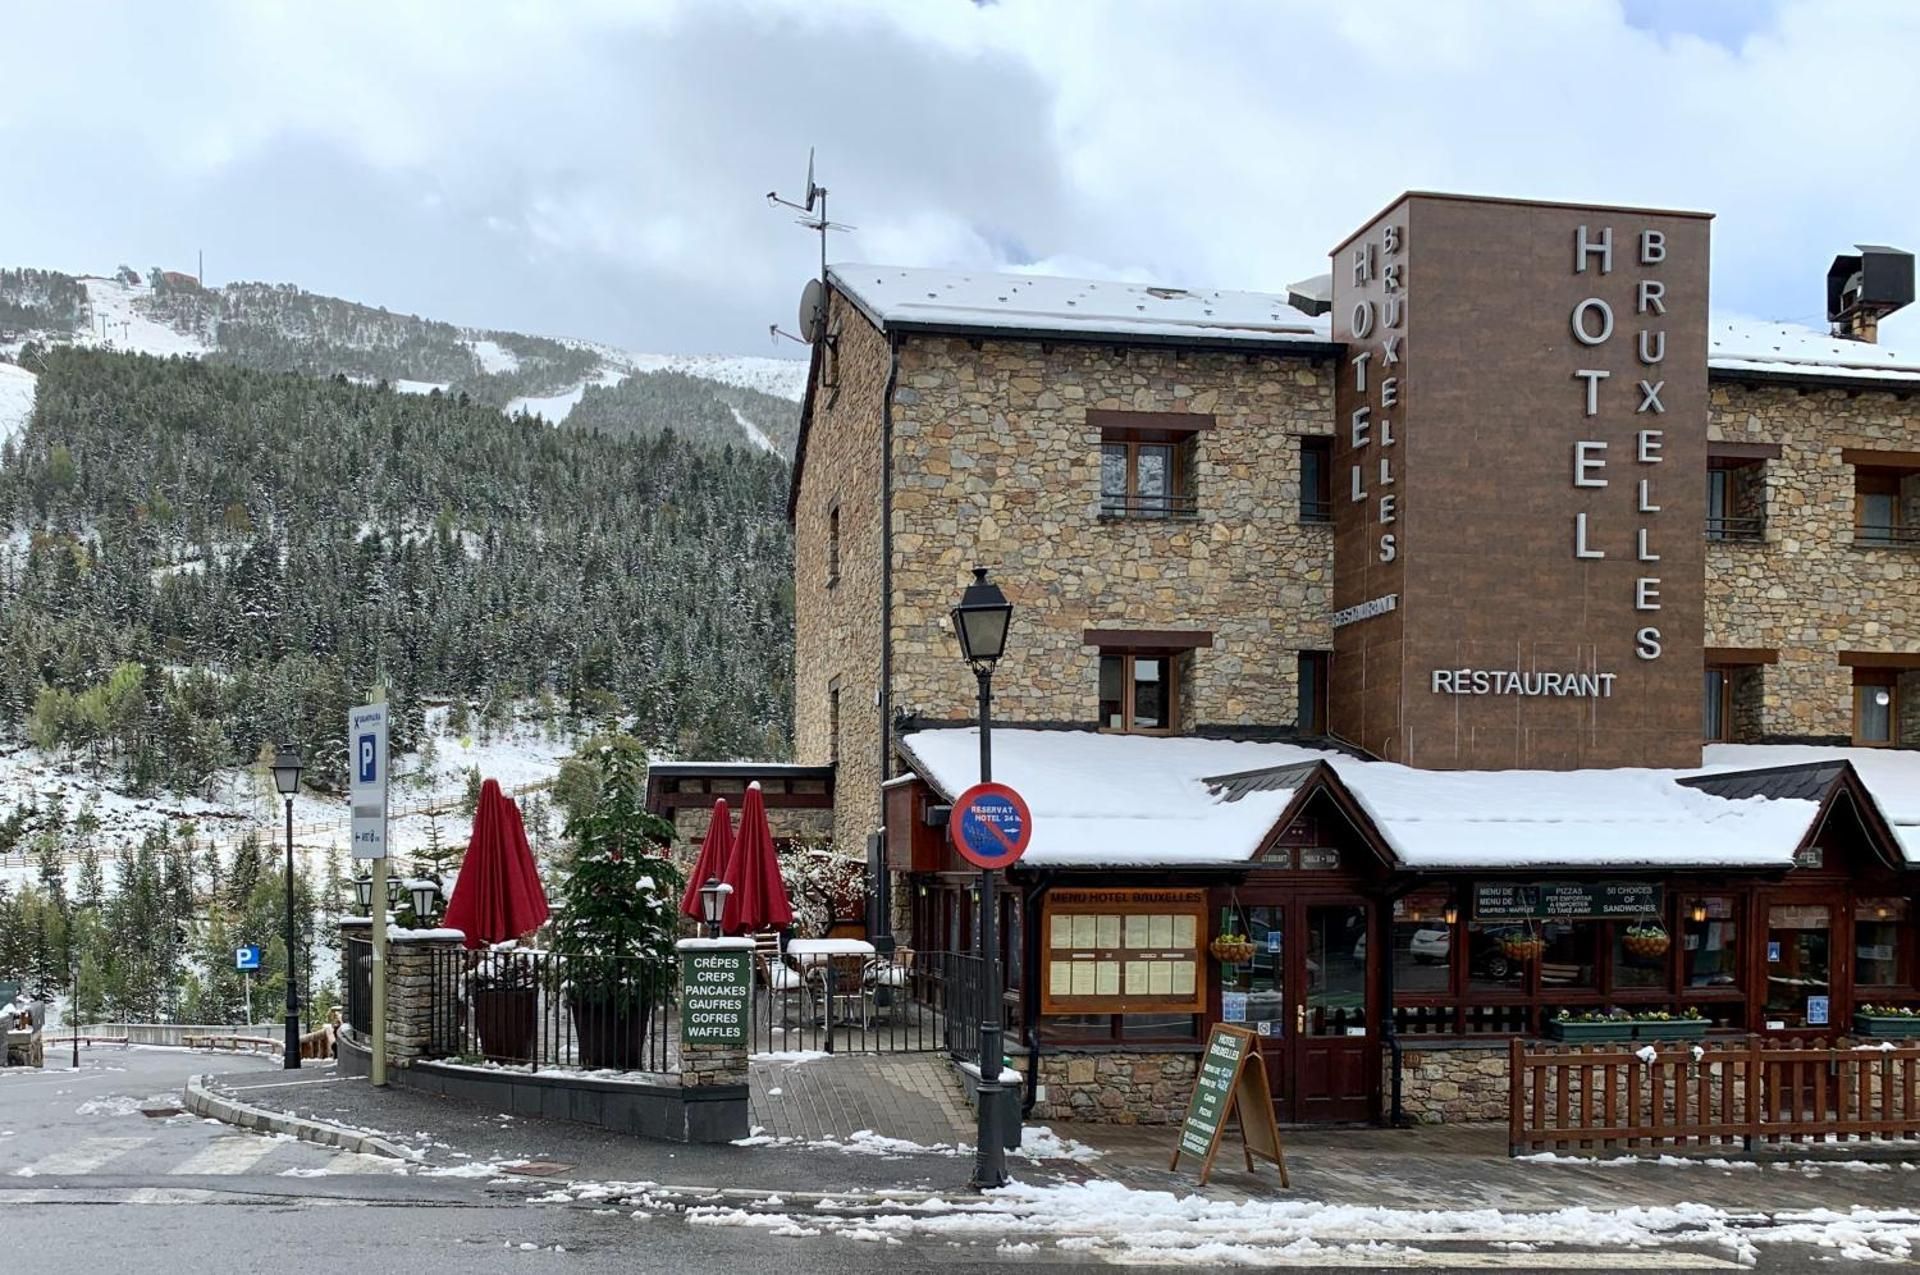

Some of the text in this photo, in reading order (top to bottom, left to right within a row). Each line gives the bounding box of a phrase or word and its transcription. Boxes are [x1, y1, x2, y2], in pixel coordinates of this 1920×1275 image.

[1353, 243, 1374, 502] HOTEL
[1380, 225, 1399, 562] BRUXELLES
[1572, 225, 1613, 559] HOTEL
[1636, 229, 1667, 660] BRUXELLES
[1432, 668, 1617, 697] RESTAURANT
[361, 741, 373, 776] P
[971, 806, 1013, 814] RESERVAT
[1051, 892, 1202, 902] MENU HOTEL BRUXELLES
[1480, 888, 1501, 896] MENU
[236, 949, 251, 968] P
[697, 972, 735, 982] CREPS
[685, 985, 746, 996] PANCAKES
[689, 999, 742, 1010] GAUFRES
[692, 1013, 738, 1024] GOFRES
[688, 1027, 741, 1037] WAFFLES
